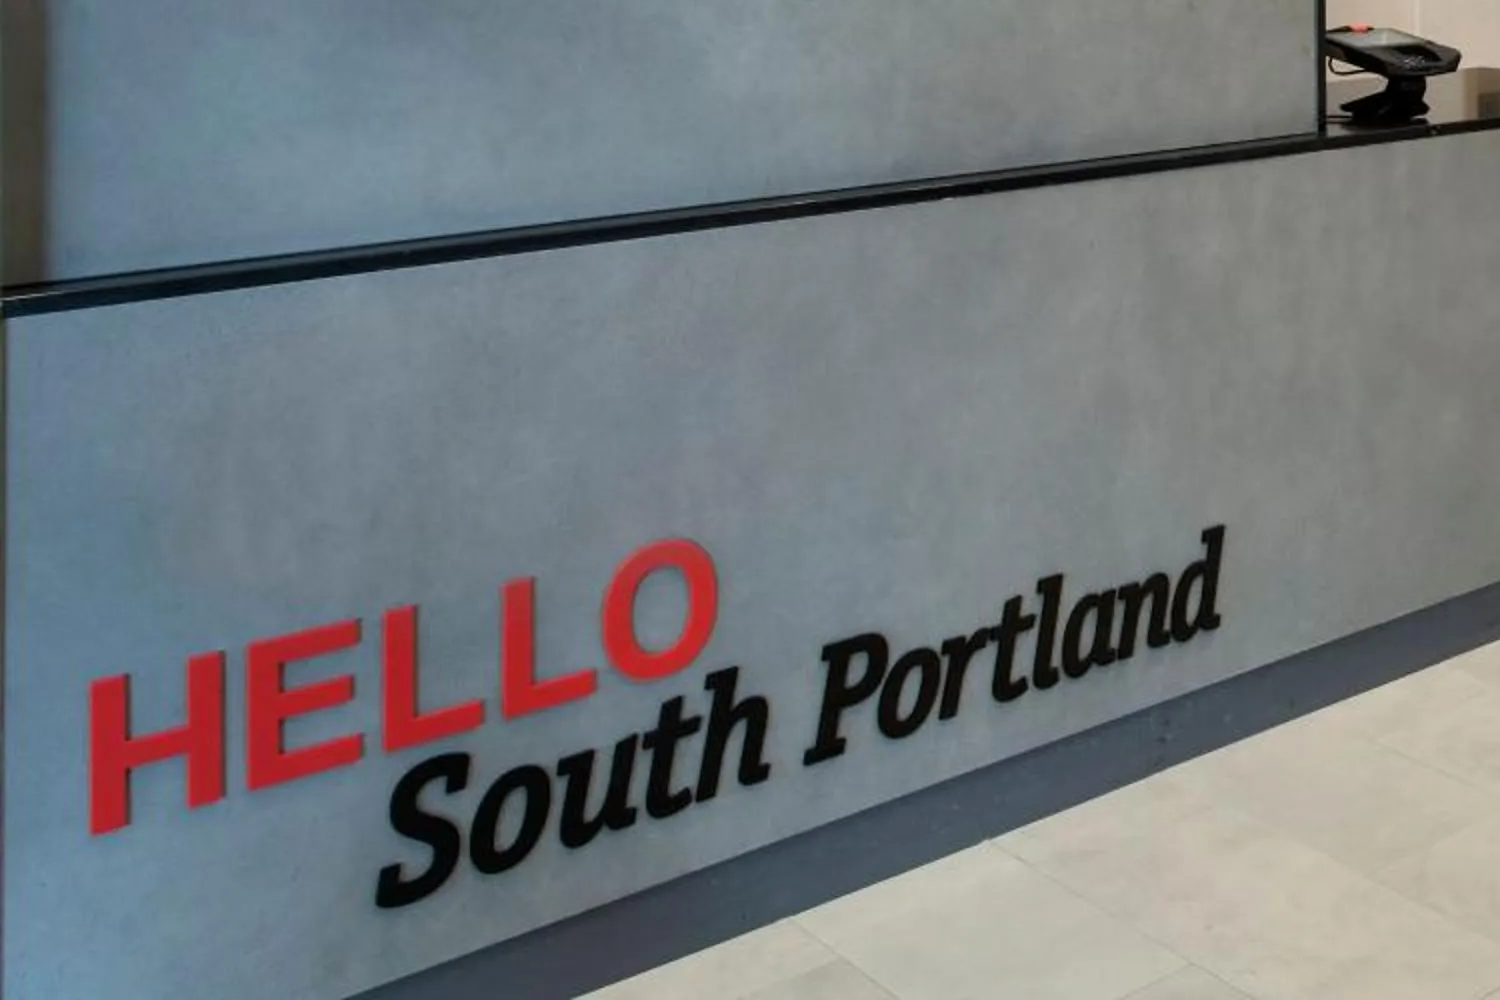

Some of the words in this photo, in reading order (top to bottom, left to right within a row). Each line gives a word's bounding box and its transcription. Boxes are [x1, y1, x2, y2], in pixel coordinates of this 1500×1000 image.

[88, 537, 718, 836] HELLO
[376, 666, 770, 909] South
[802, 525, 1226, 766] Portland
